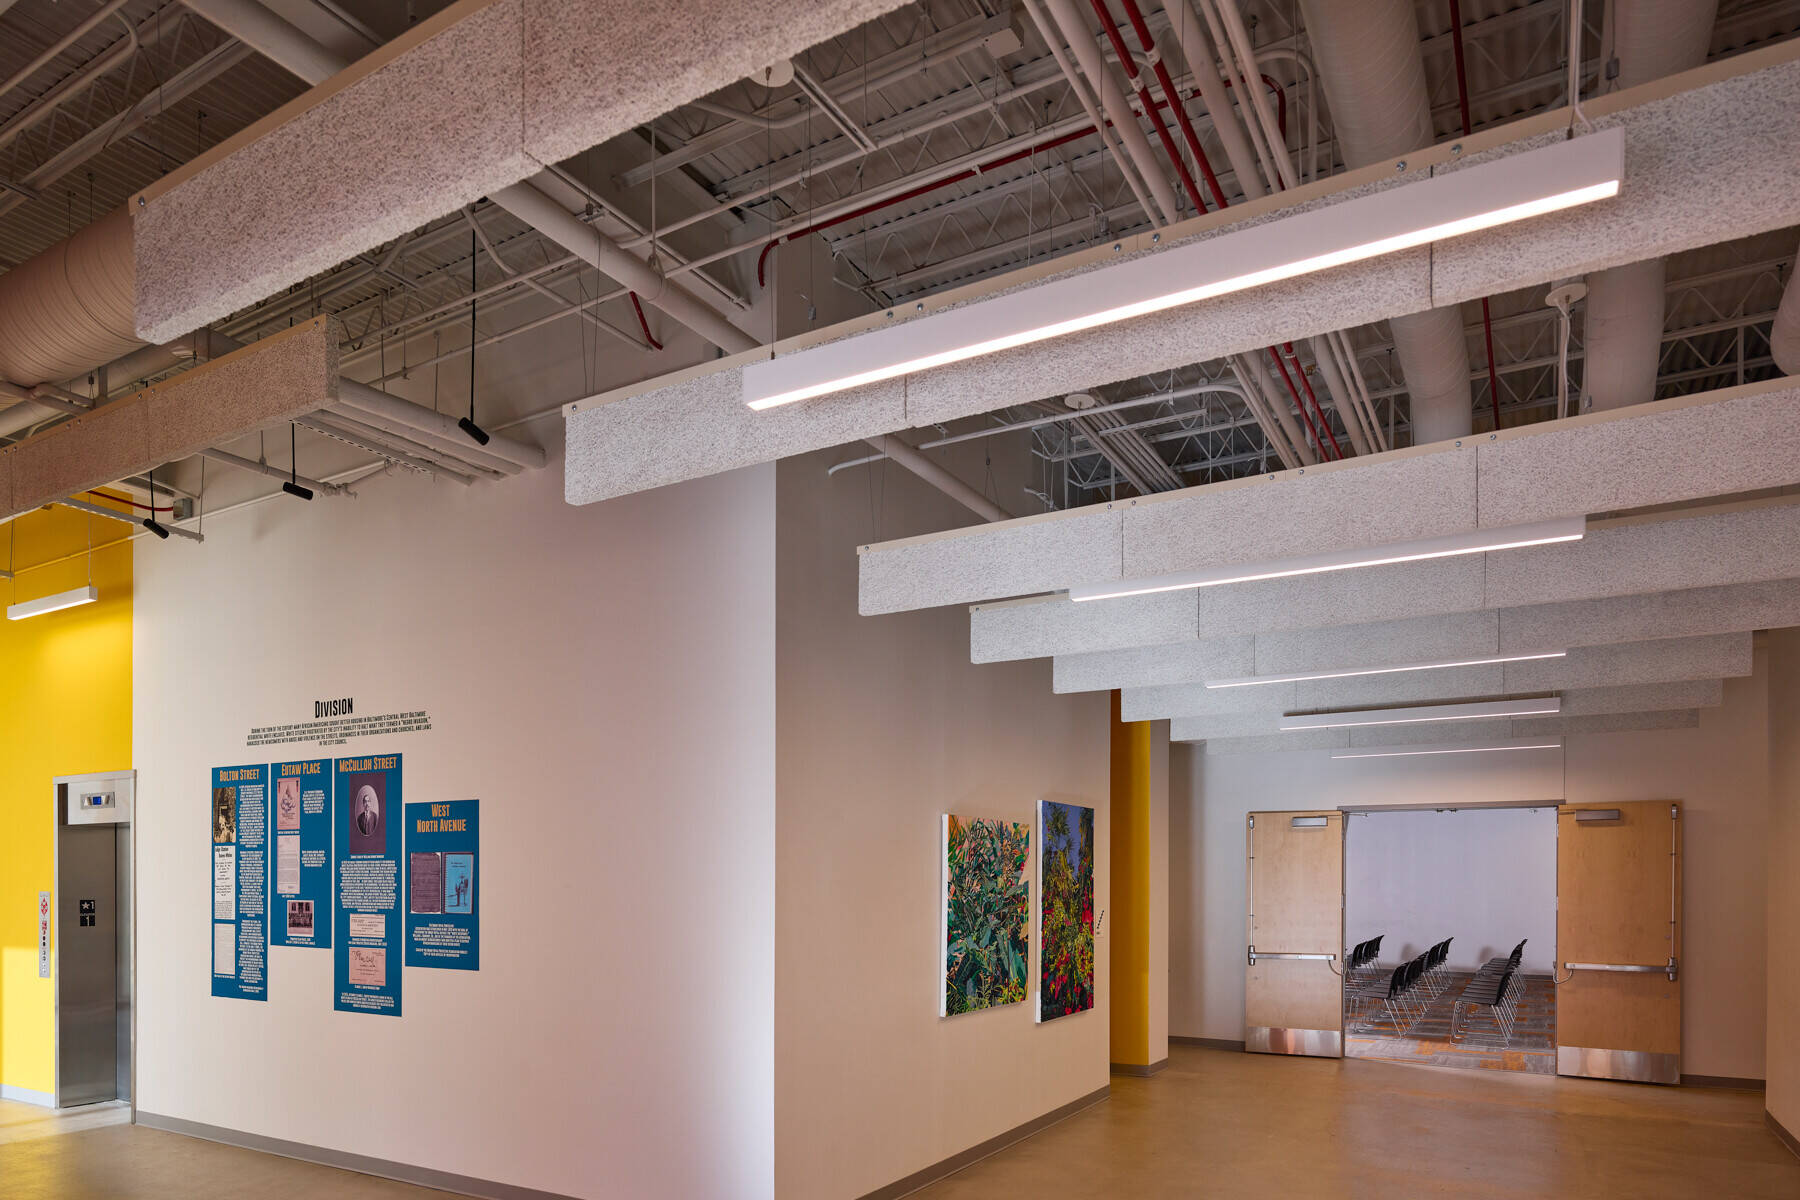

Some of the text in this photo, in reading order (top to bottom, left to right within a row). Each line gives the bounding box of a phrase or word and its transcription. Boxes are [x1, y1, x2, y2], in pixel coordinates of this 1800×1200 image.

[315, 698, 353, 718] DIVISION
[282, 762, 320, 776] EUTAW PLACE
[374, 757, 396, 770] STREET
[220, 768, 260, 782] BOLTON STREET
[432, 804, 450, 817] WEST
[416, 819, 466, 832] NORTH AVENUE
